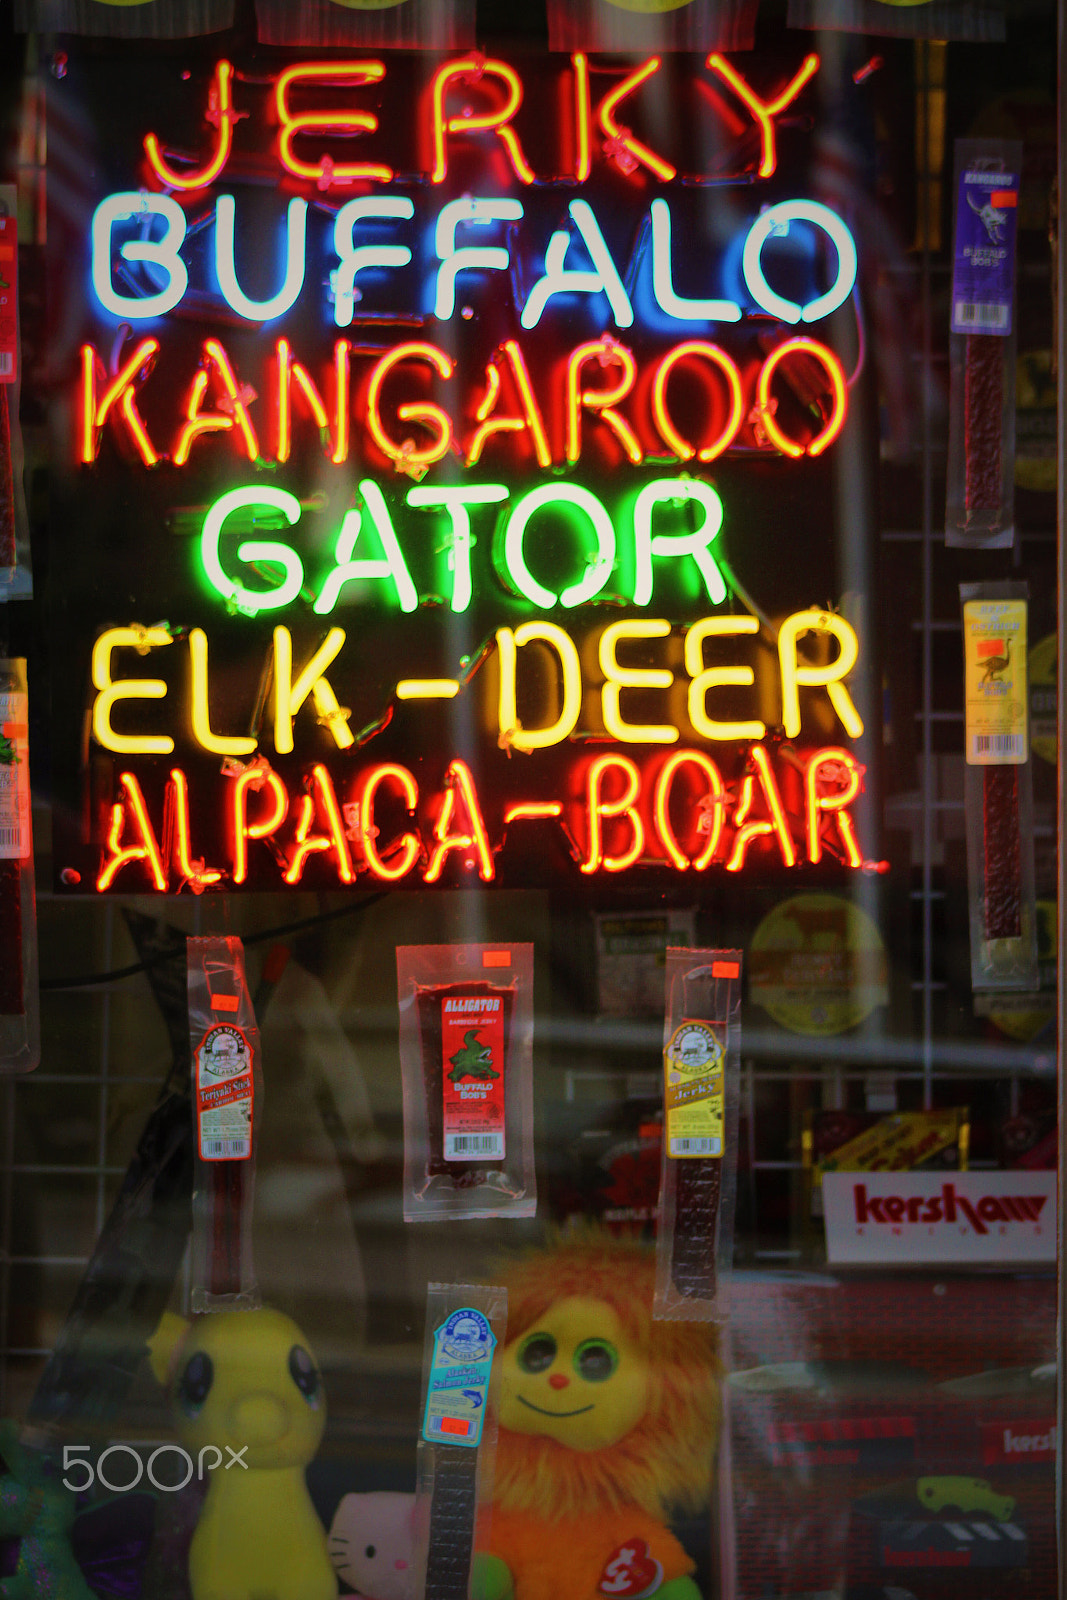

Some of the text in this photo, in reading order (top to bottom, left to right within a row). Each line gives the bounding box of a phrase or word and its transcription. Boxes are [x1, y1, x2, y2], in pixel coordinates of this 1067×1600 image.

[143, 52, 819, 191] JERKY
[91, 191, 858, 329] BUFFALO
[79, 336, 850, 468] KANGAROO
[199, 477, 728, 616] GATOR
[970, 622, 1021, 631] OSTRICH
[445, 999, 501, 1013] ALLIGATOR
[200, 1077, 251, 1102] Teriyaki Stick
[454, 1082, 494, 1092] BUFFALO
[460, 1091, 487, 1100] BOB'S
[675, 1082, 716, 1100] Jerky
[854, 1183, 1048, 1235] kershaw
[447, 1311, 488, 1336] INDIAN VALLEY
[433, 1374, 487, 1390] Salmon Jerky
[446, 1365, 478, 1378] Alaskan
